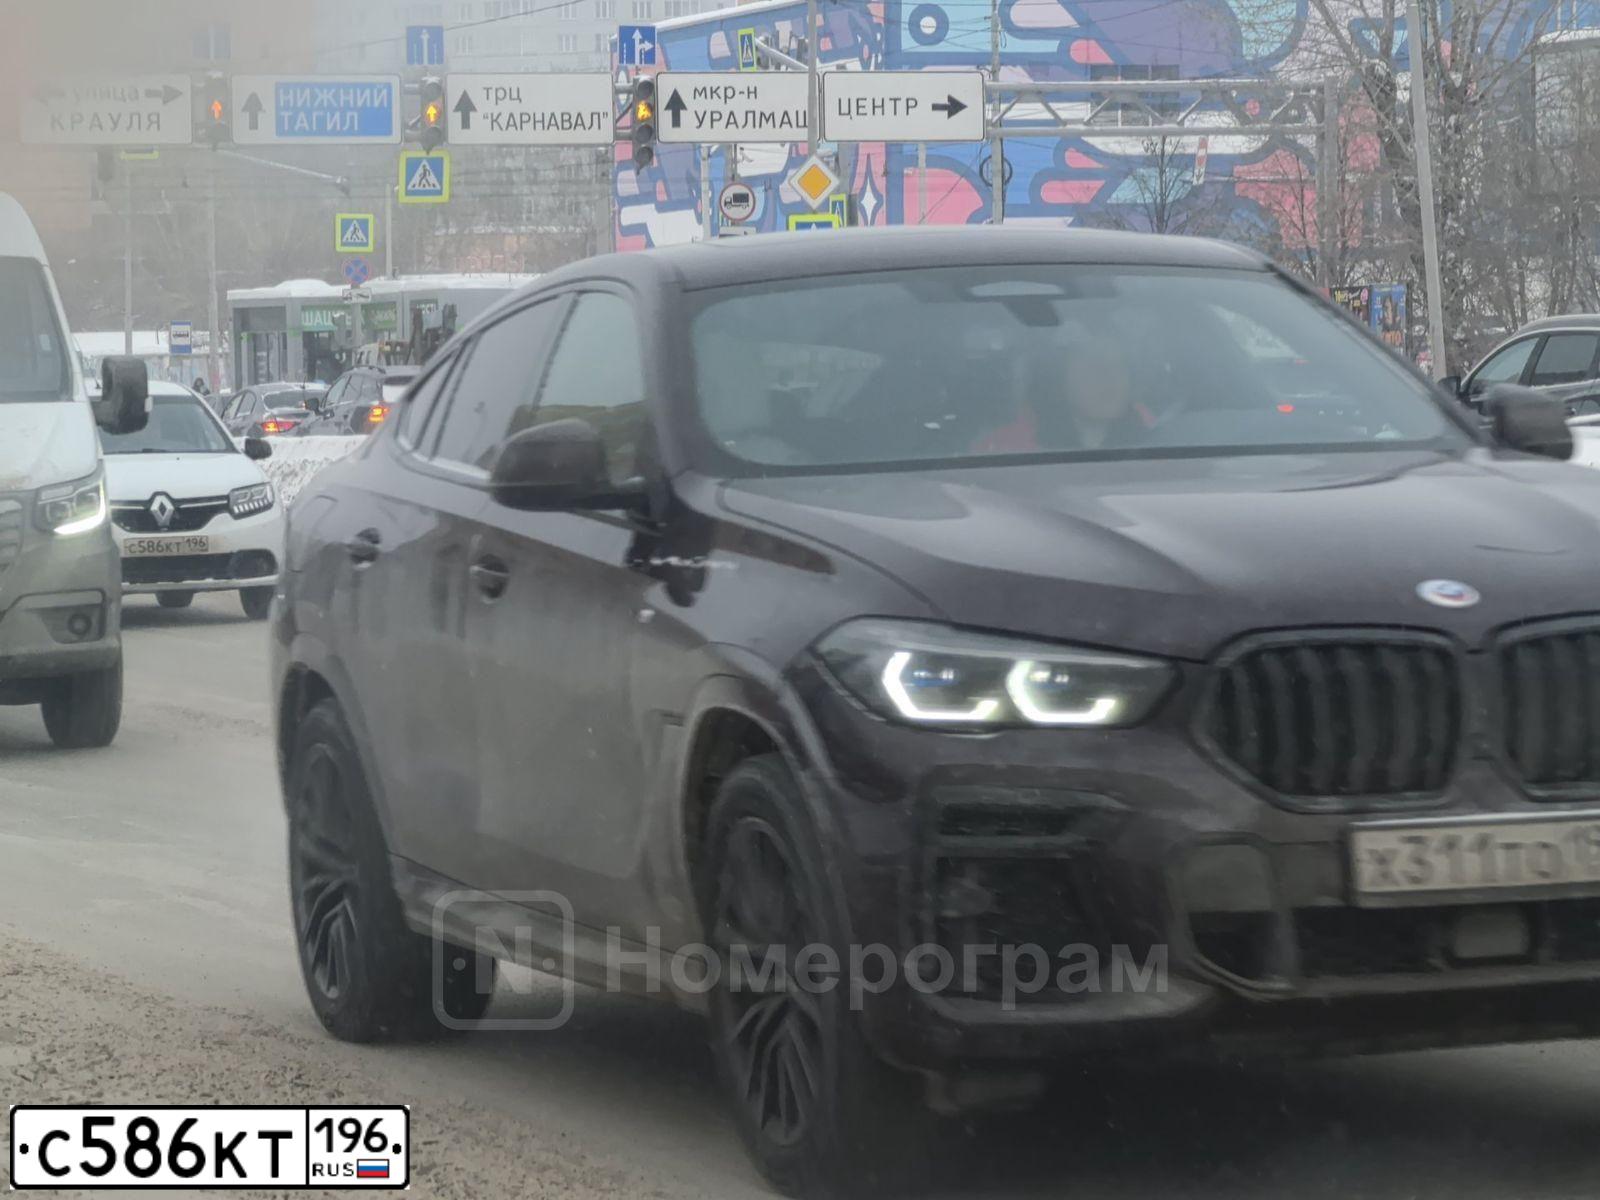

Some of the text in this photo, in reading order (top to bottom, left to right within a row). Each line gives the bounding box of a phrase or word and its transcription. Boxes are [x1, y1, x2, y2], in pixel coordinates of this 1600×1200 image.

[279, 84, 387, 108] НИЖНИЙ
[483, 86, 522, 105] трц
[693, 85, 758, 104] мкр-н
[838, 97, 918, 120] ЦЕНТР
[50, 112, 160, 131] КРАУЛЯ
[280, 111, 358, 131] ТАГИЛ
[483, 112, 608, 131] "КАРНАВАЛ"
[128, 537, 206, 554] С586КТ 196
